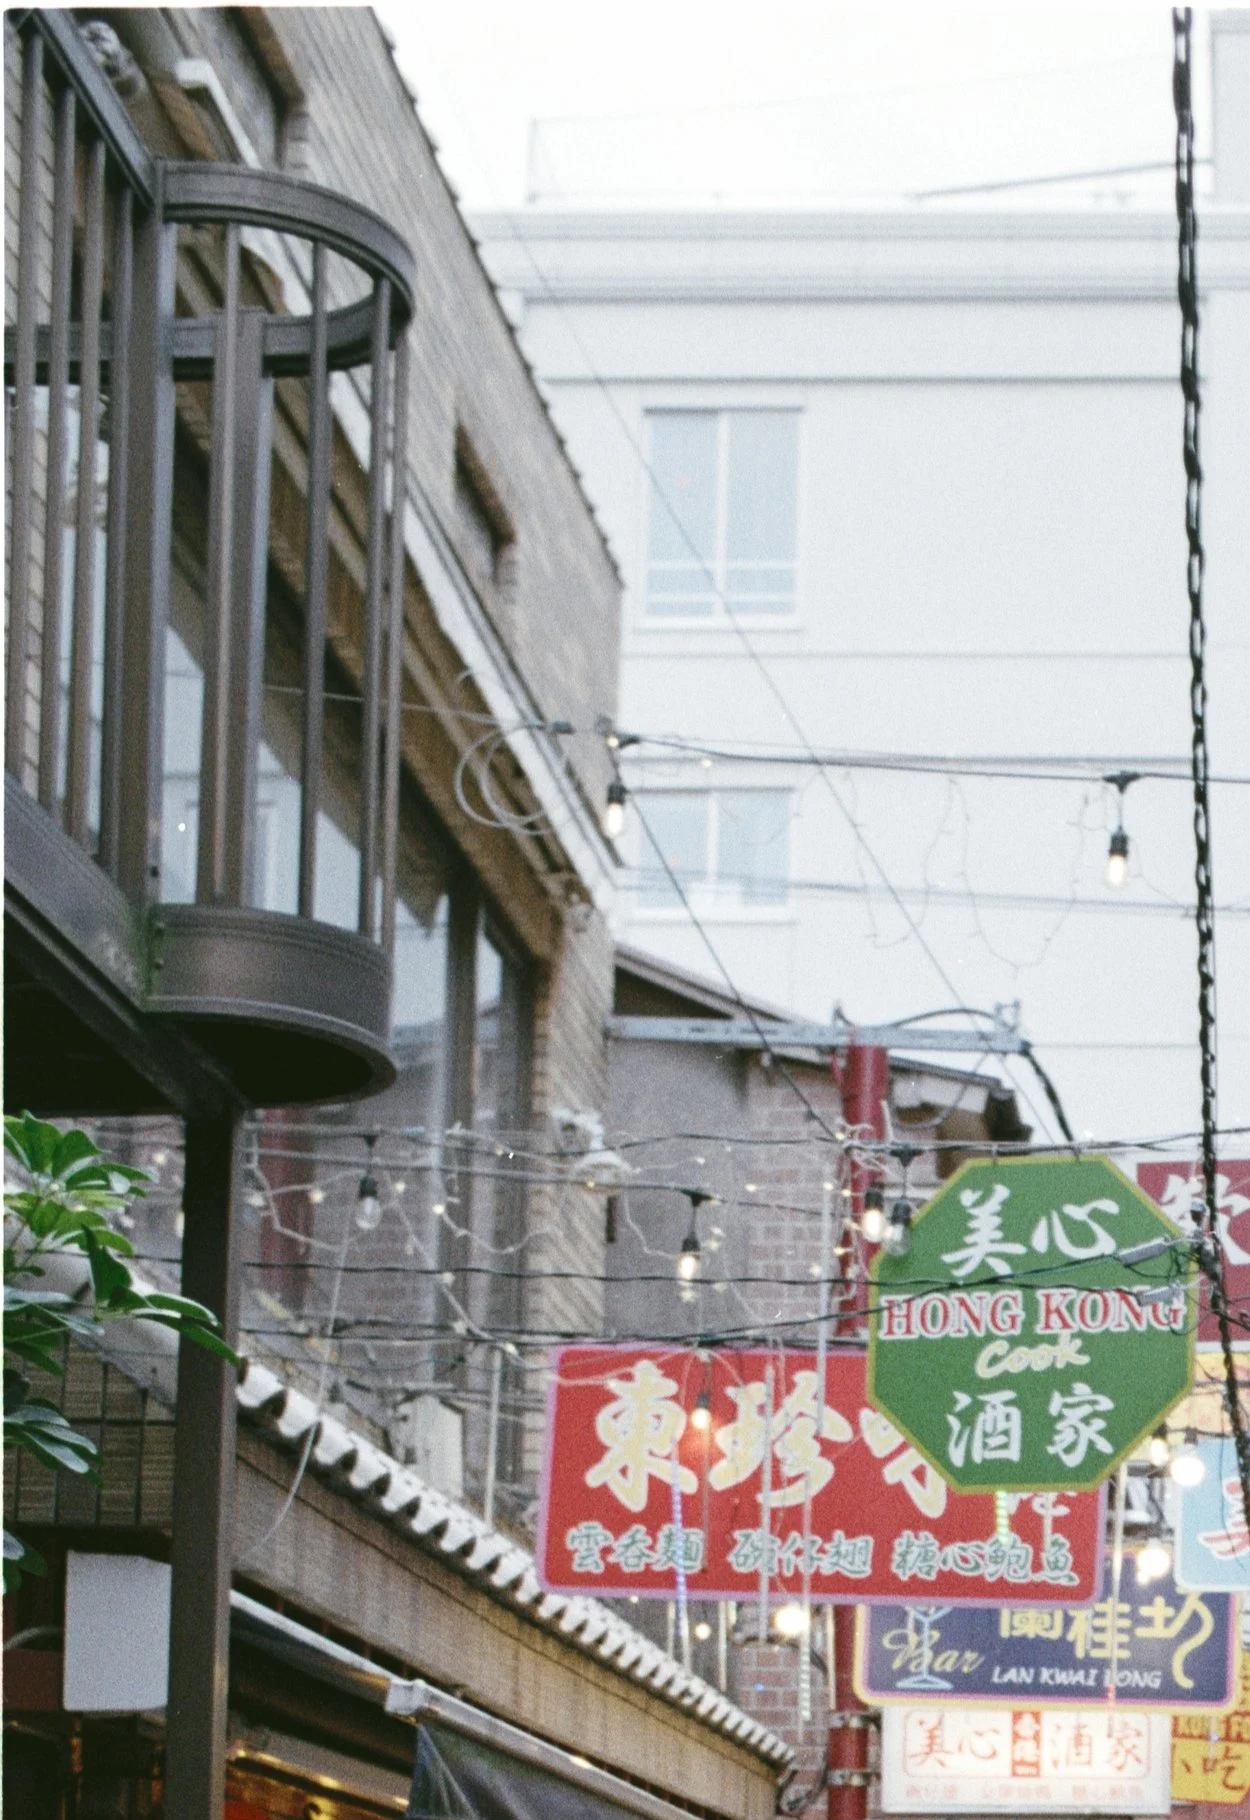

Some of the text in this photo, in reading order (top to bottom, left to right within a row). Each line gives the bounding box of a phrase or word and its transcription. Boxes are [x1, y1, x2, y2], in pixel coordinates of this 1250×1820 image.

[942, 1184, 1120, 1278] 美心
[882, 1290, 1186, 1338] HONG KONG
[975, 1336, 1091, 1378] Cook
[946, 1383, 1116, 1468] 酒家
[882, 1628, 985, 1674] Bar
[991, 1667, 1033, 1684] LAN
[1039, 1668, 1095, 1687] KWAI
